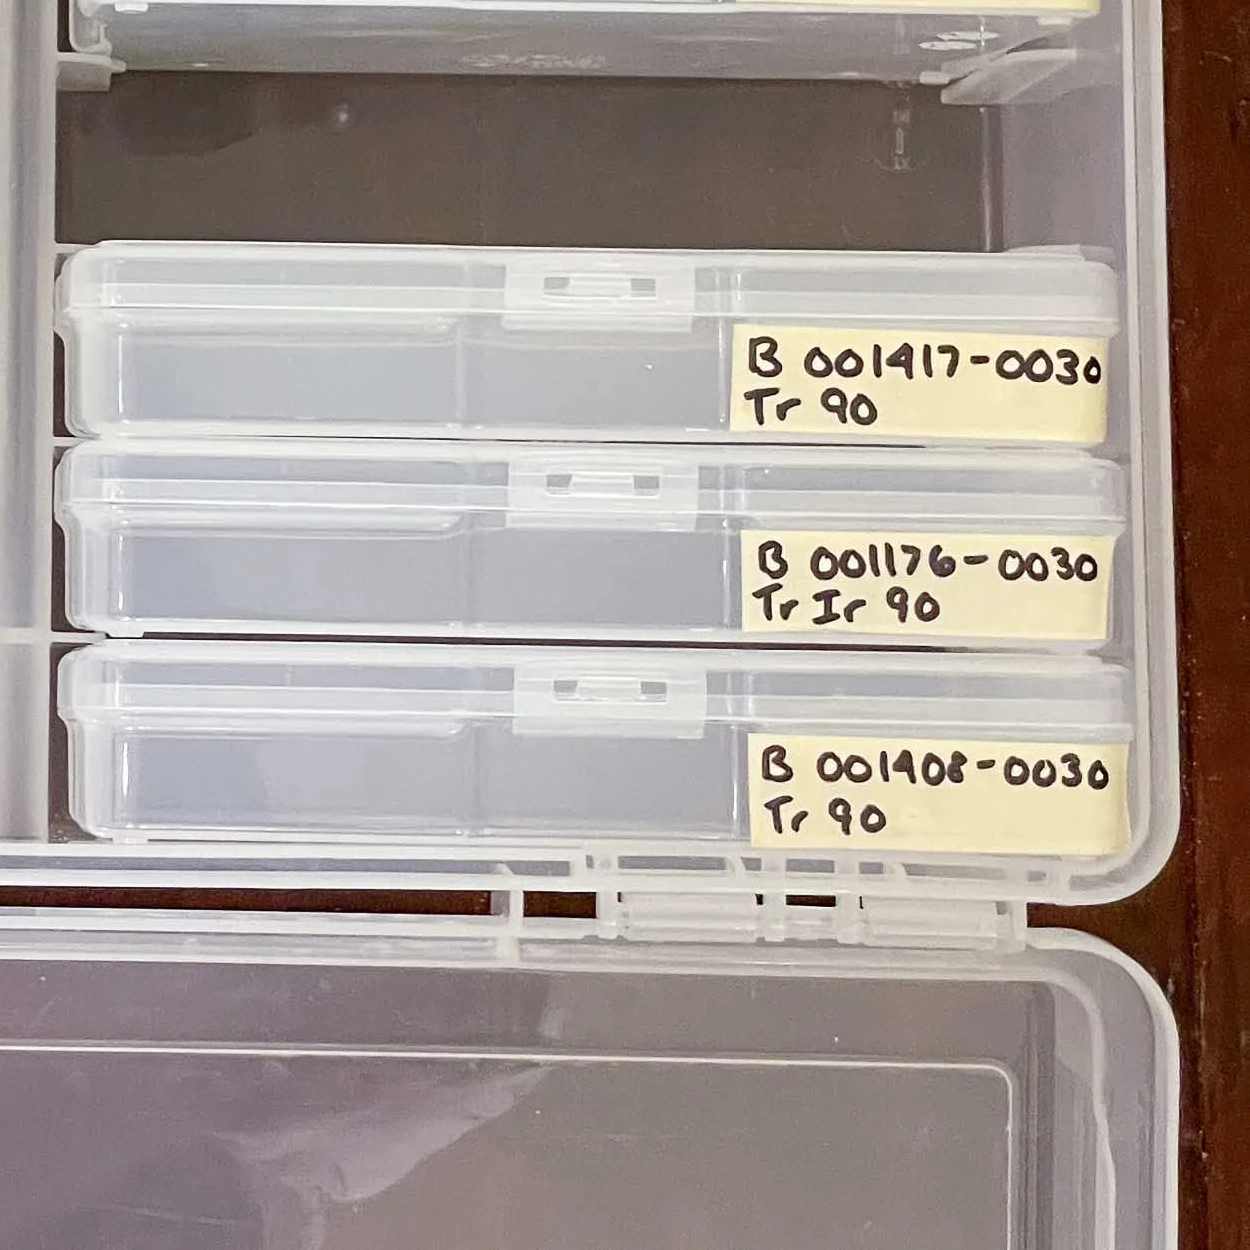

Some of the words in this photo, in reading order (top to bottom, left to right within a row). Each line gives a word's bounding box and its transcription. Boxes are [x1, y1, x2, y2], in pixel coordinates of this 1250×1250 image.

[747, 335, 784, 379] B
[802, 341, 1103, 387] 001417-0030
[742, 386, 803, 427] Tr
[819, 386, 879, 427] 90
[757, 539, 790, 581] B
[809, 541, 1099, 583] 001176-0030
[750, 581, 800, 622] Tr
[811, 588, 868, 626] Ir
[885, 585, 941, 624] 90
[760, 743, 795, 784] B
[815, 748, 1110, 791] 001408-0030
[763, 794, 810, 835] Tr
[827, 796, 888, 837] 90
